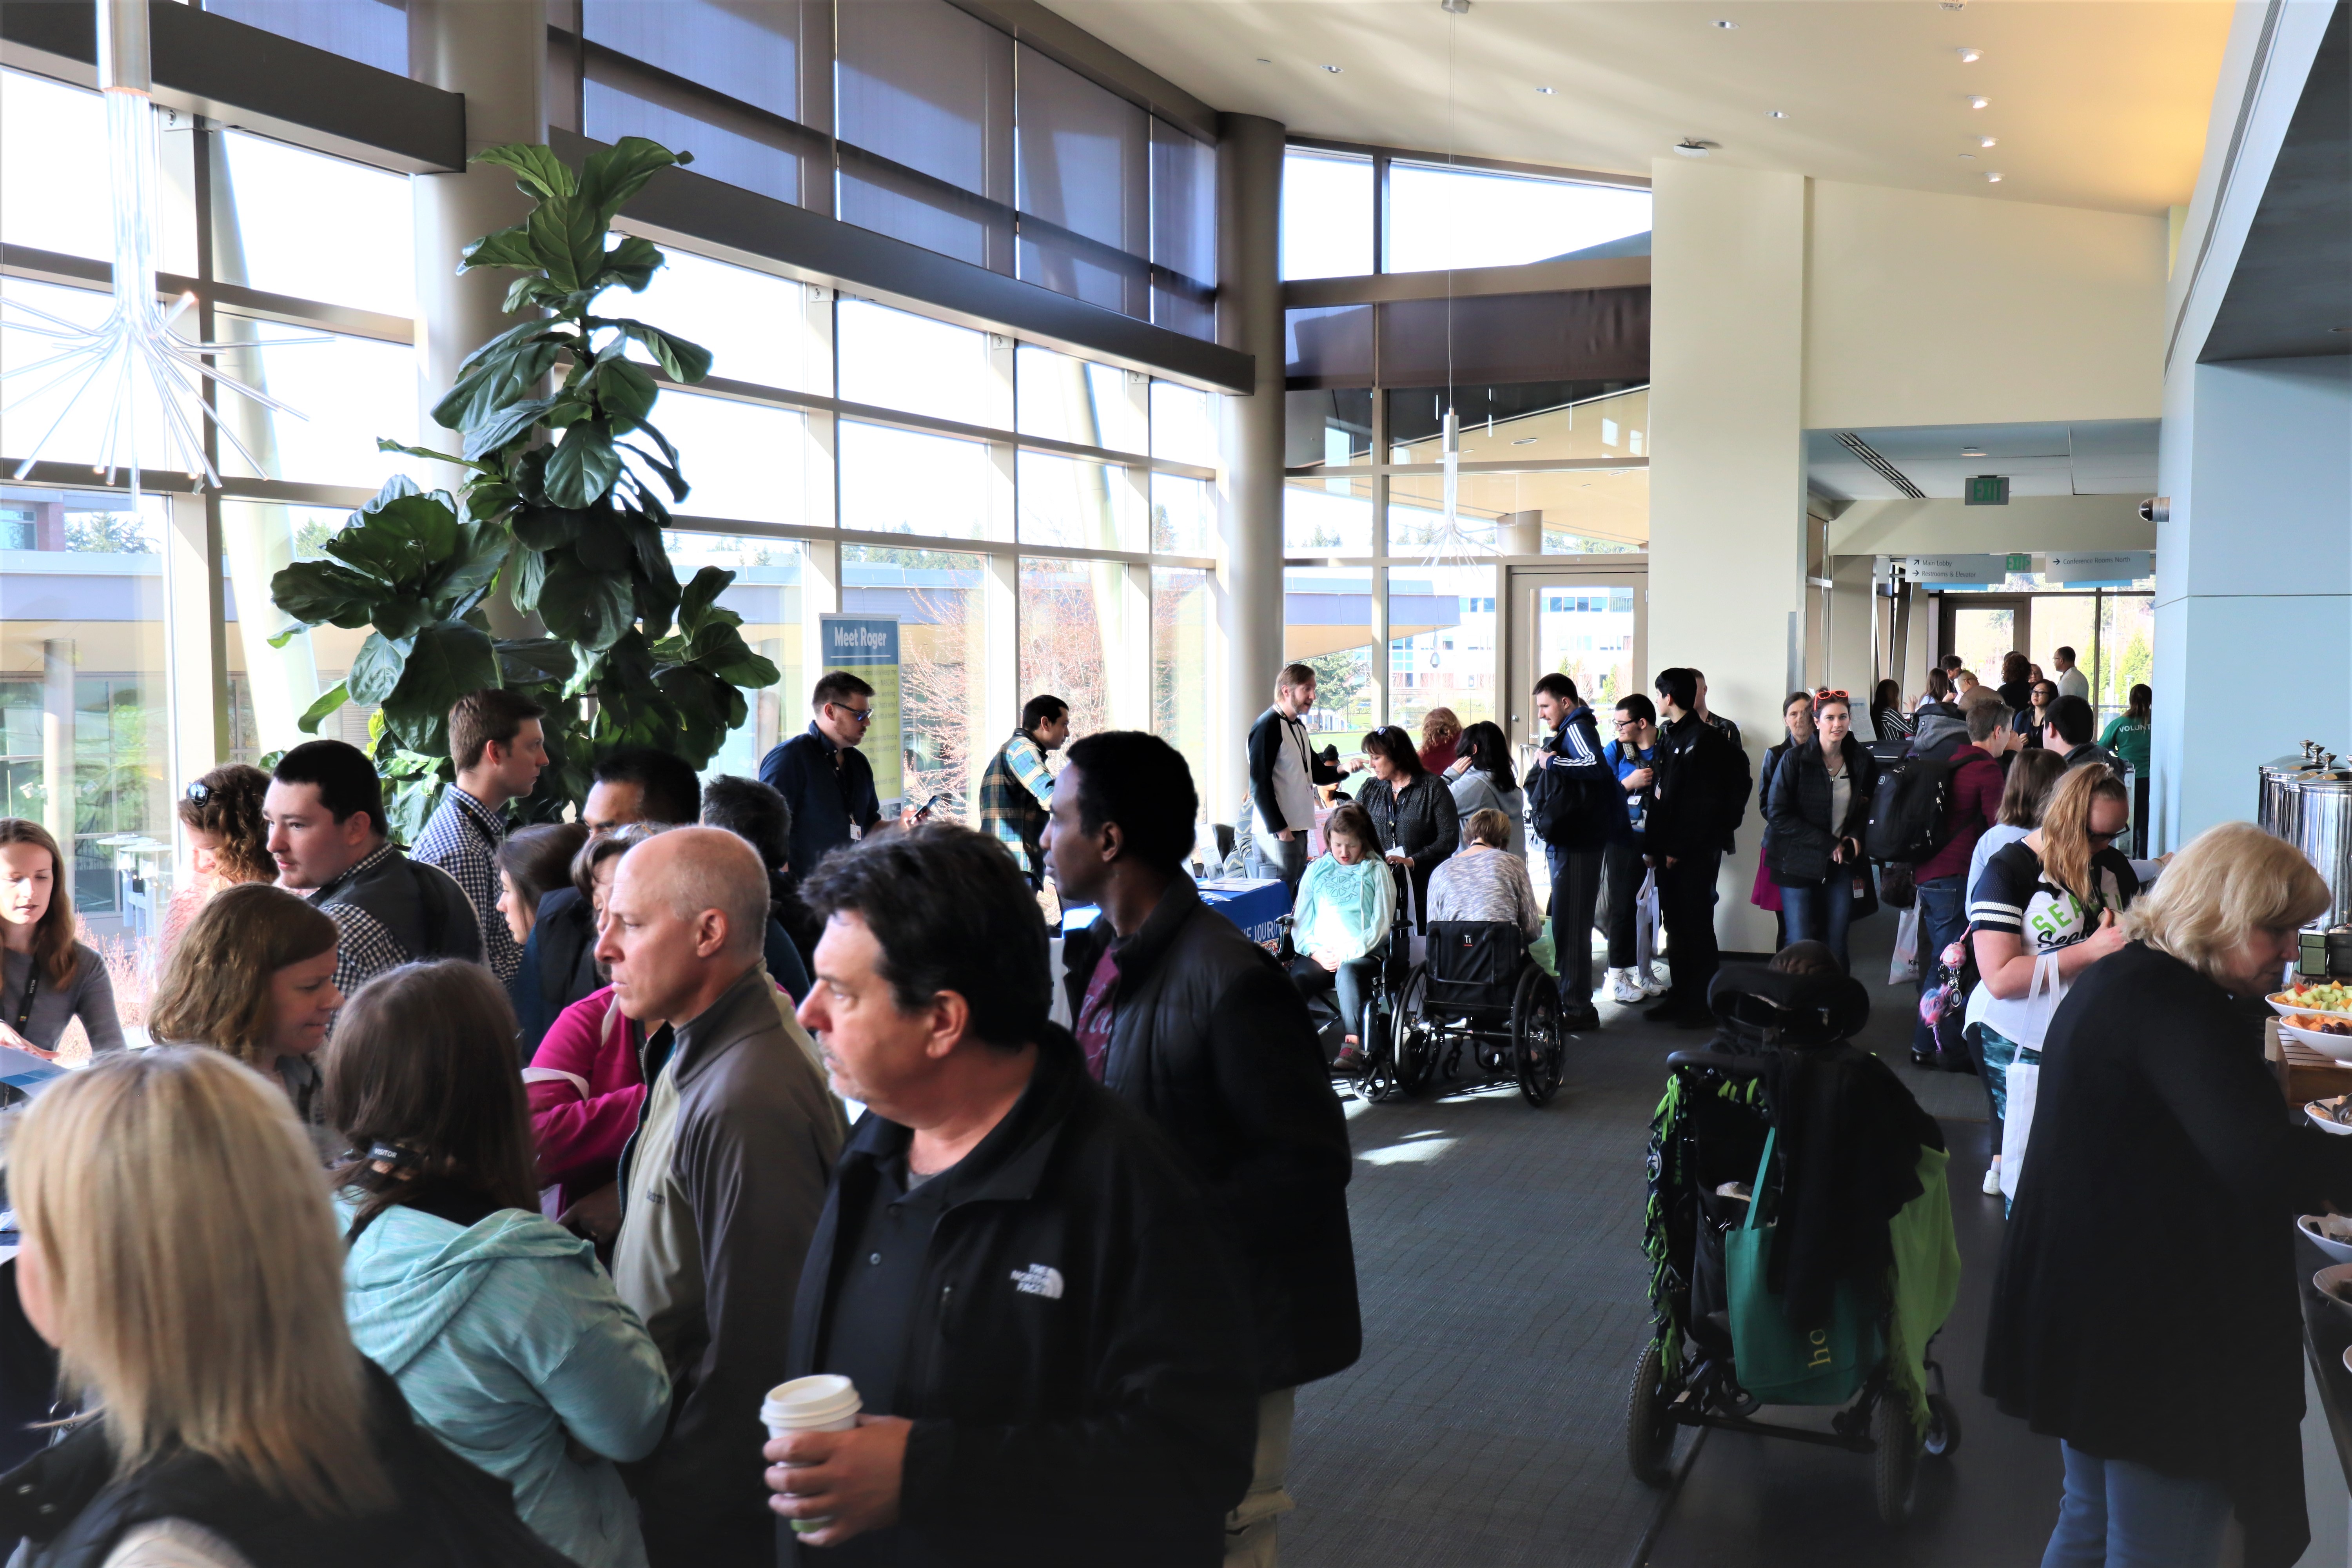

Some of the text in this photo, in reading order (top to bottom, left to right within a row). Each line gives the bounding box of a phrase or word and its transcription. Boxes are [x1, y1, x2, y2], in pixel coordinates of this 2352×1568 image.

[1974, 480, 2003, 501] EXIT
[2007, 555, 2027, 571] EXIT
[835, 627, 887, 650] Meet Roger
[1464, 935, 1471, 944] Ti
[374, 1148, 397, 1158] VISITOR
